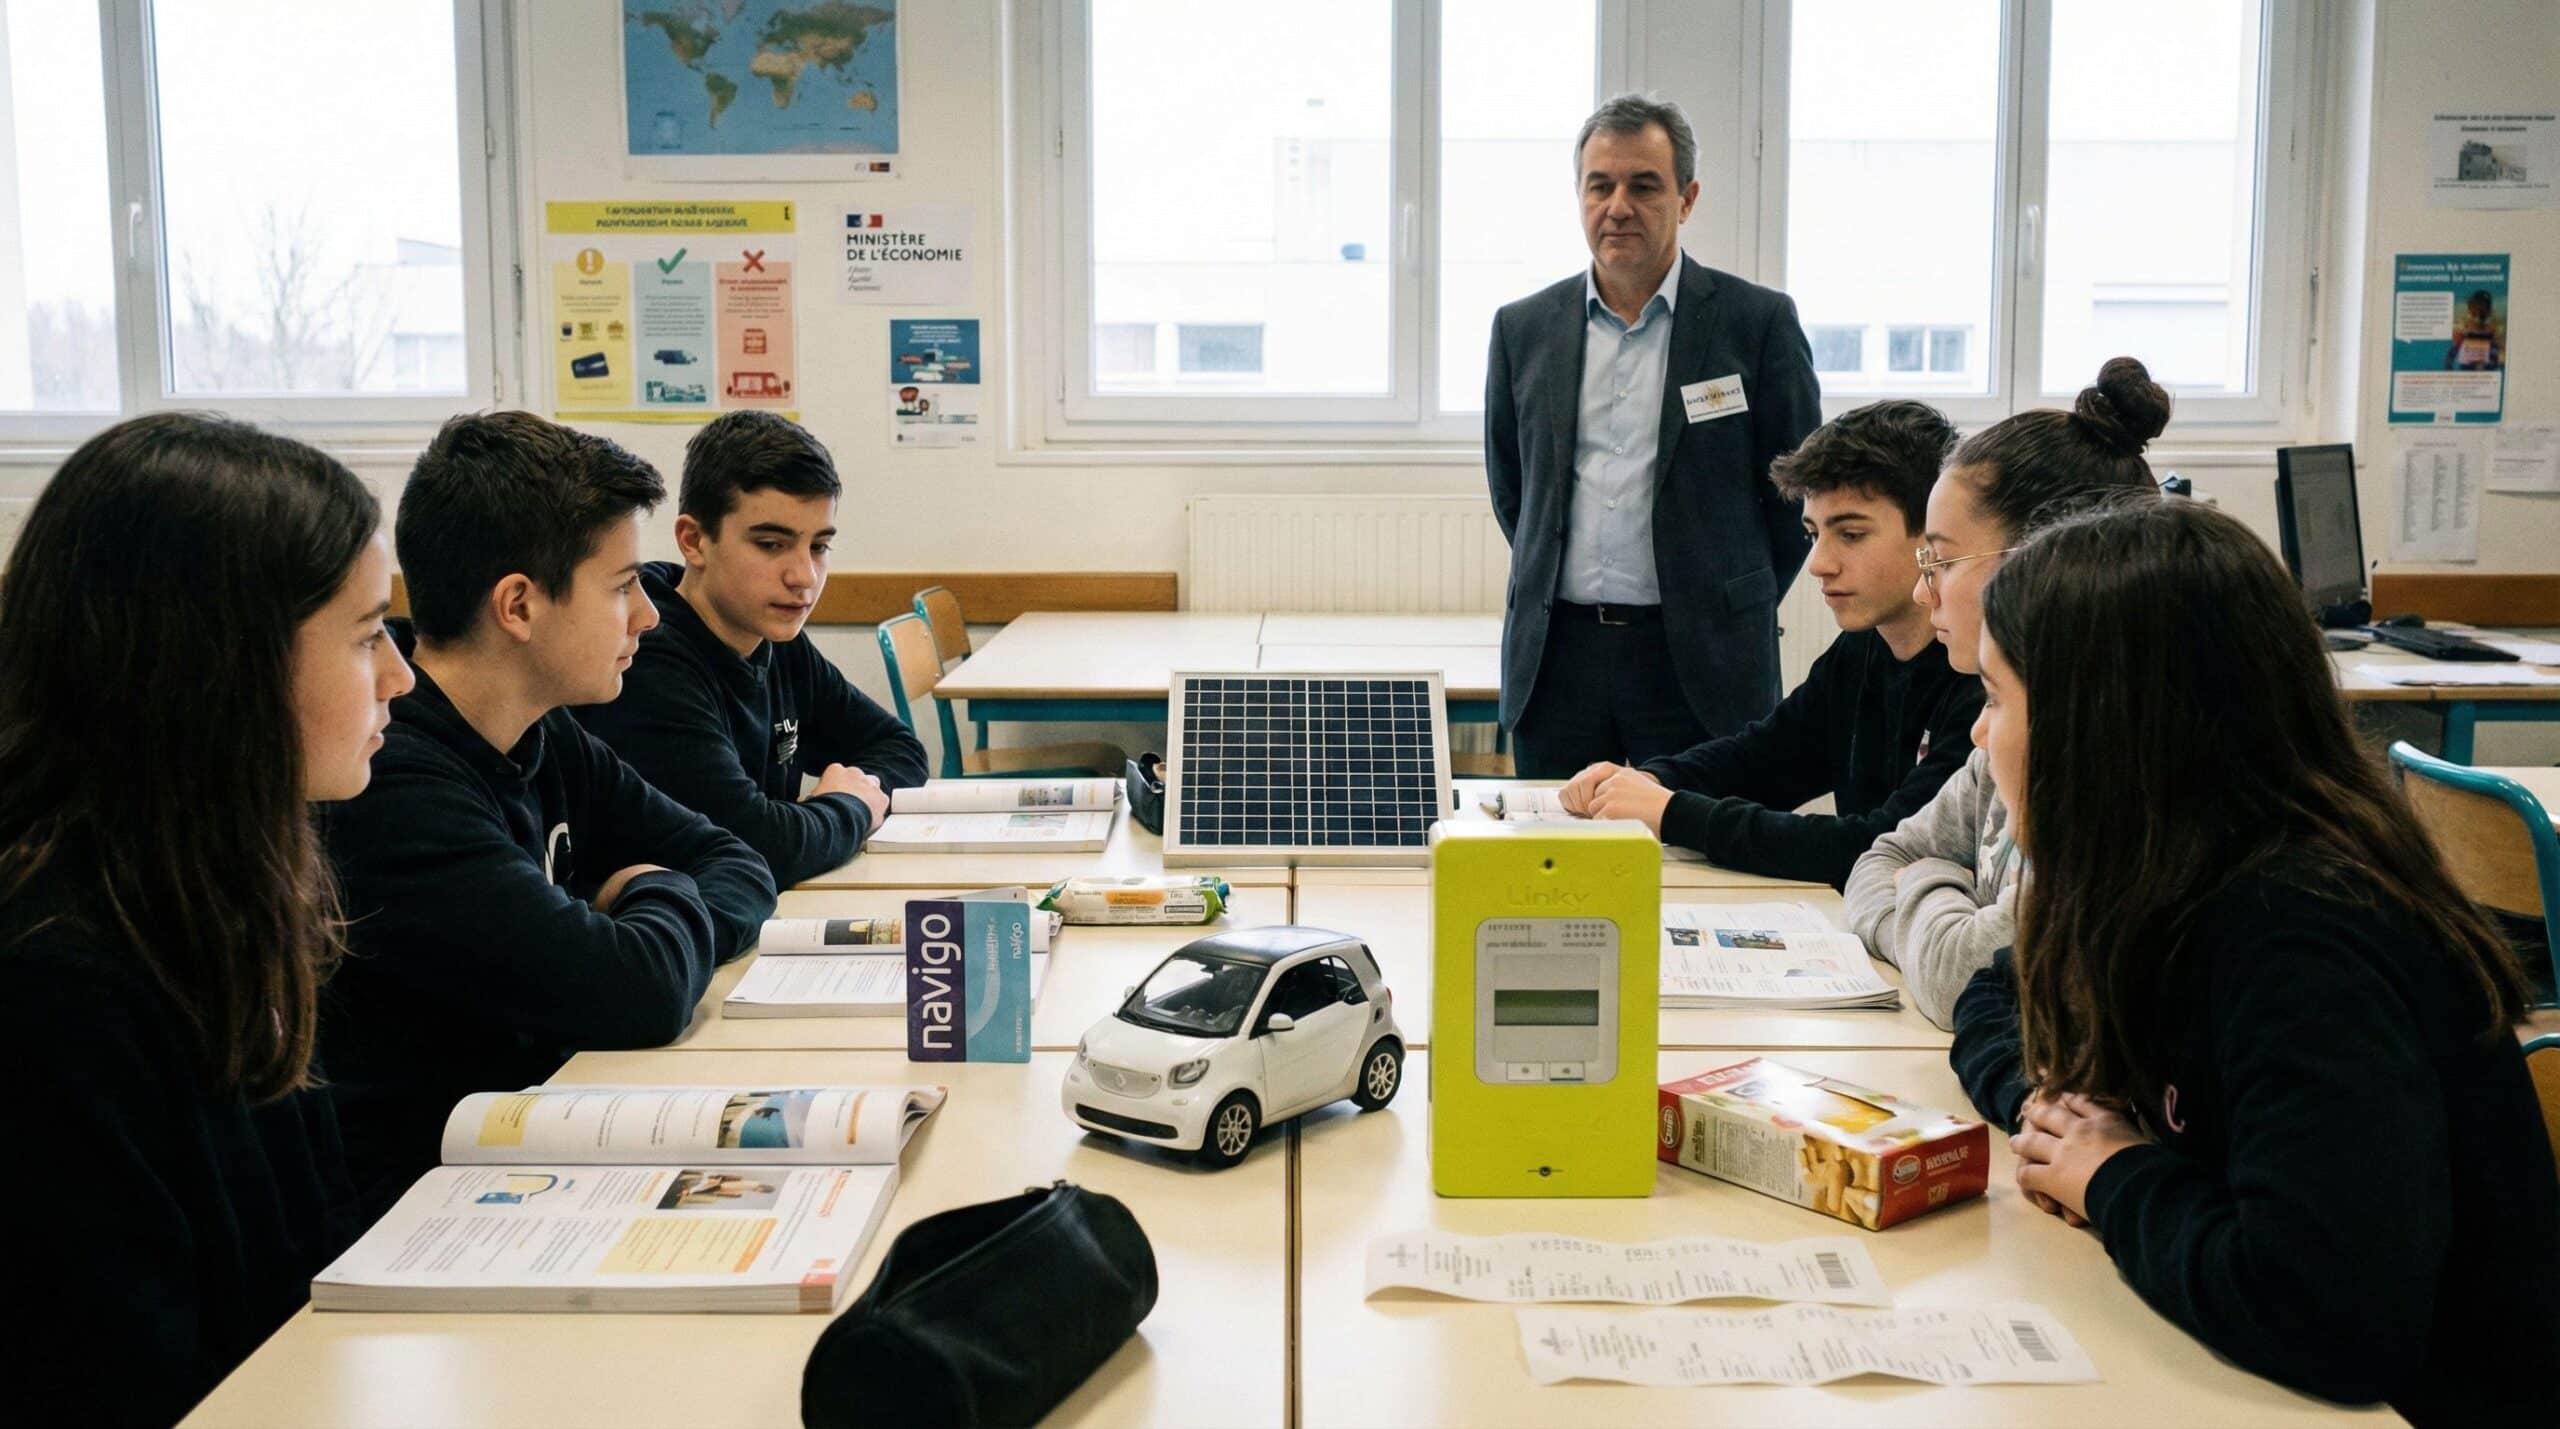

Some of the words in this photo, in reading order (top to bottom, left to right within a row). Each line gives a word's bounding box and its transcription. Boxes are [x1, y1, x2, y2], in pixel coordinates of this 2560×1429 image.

[847, 230, 926, 246] MINISTÈRE
[847, 248, 866, 261] DE
[871, 247, 962, 261] L'ÉCONOMIE
[1507, 881, 1591, 912] Linky
[912, 913, 962, 1049] navigo
